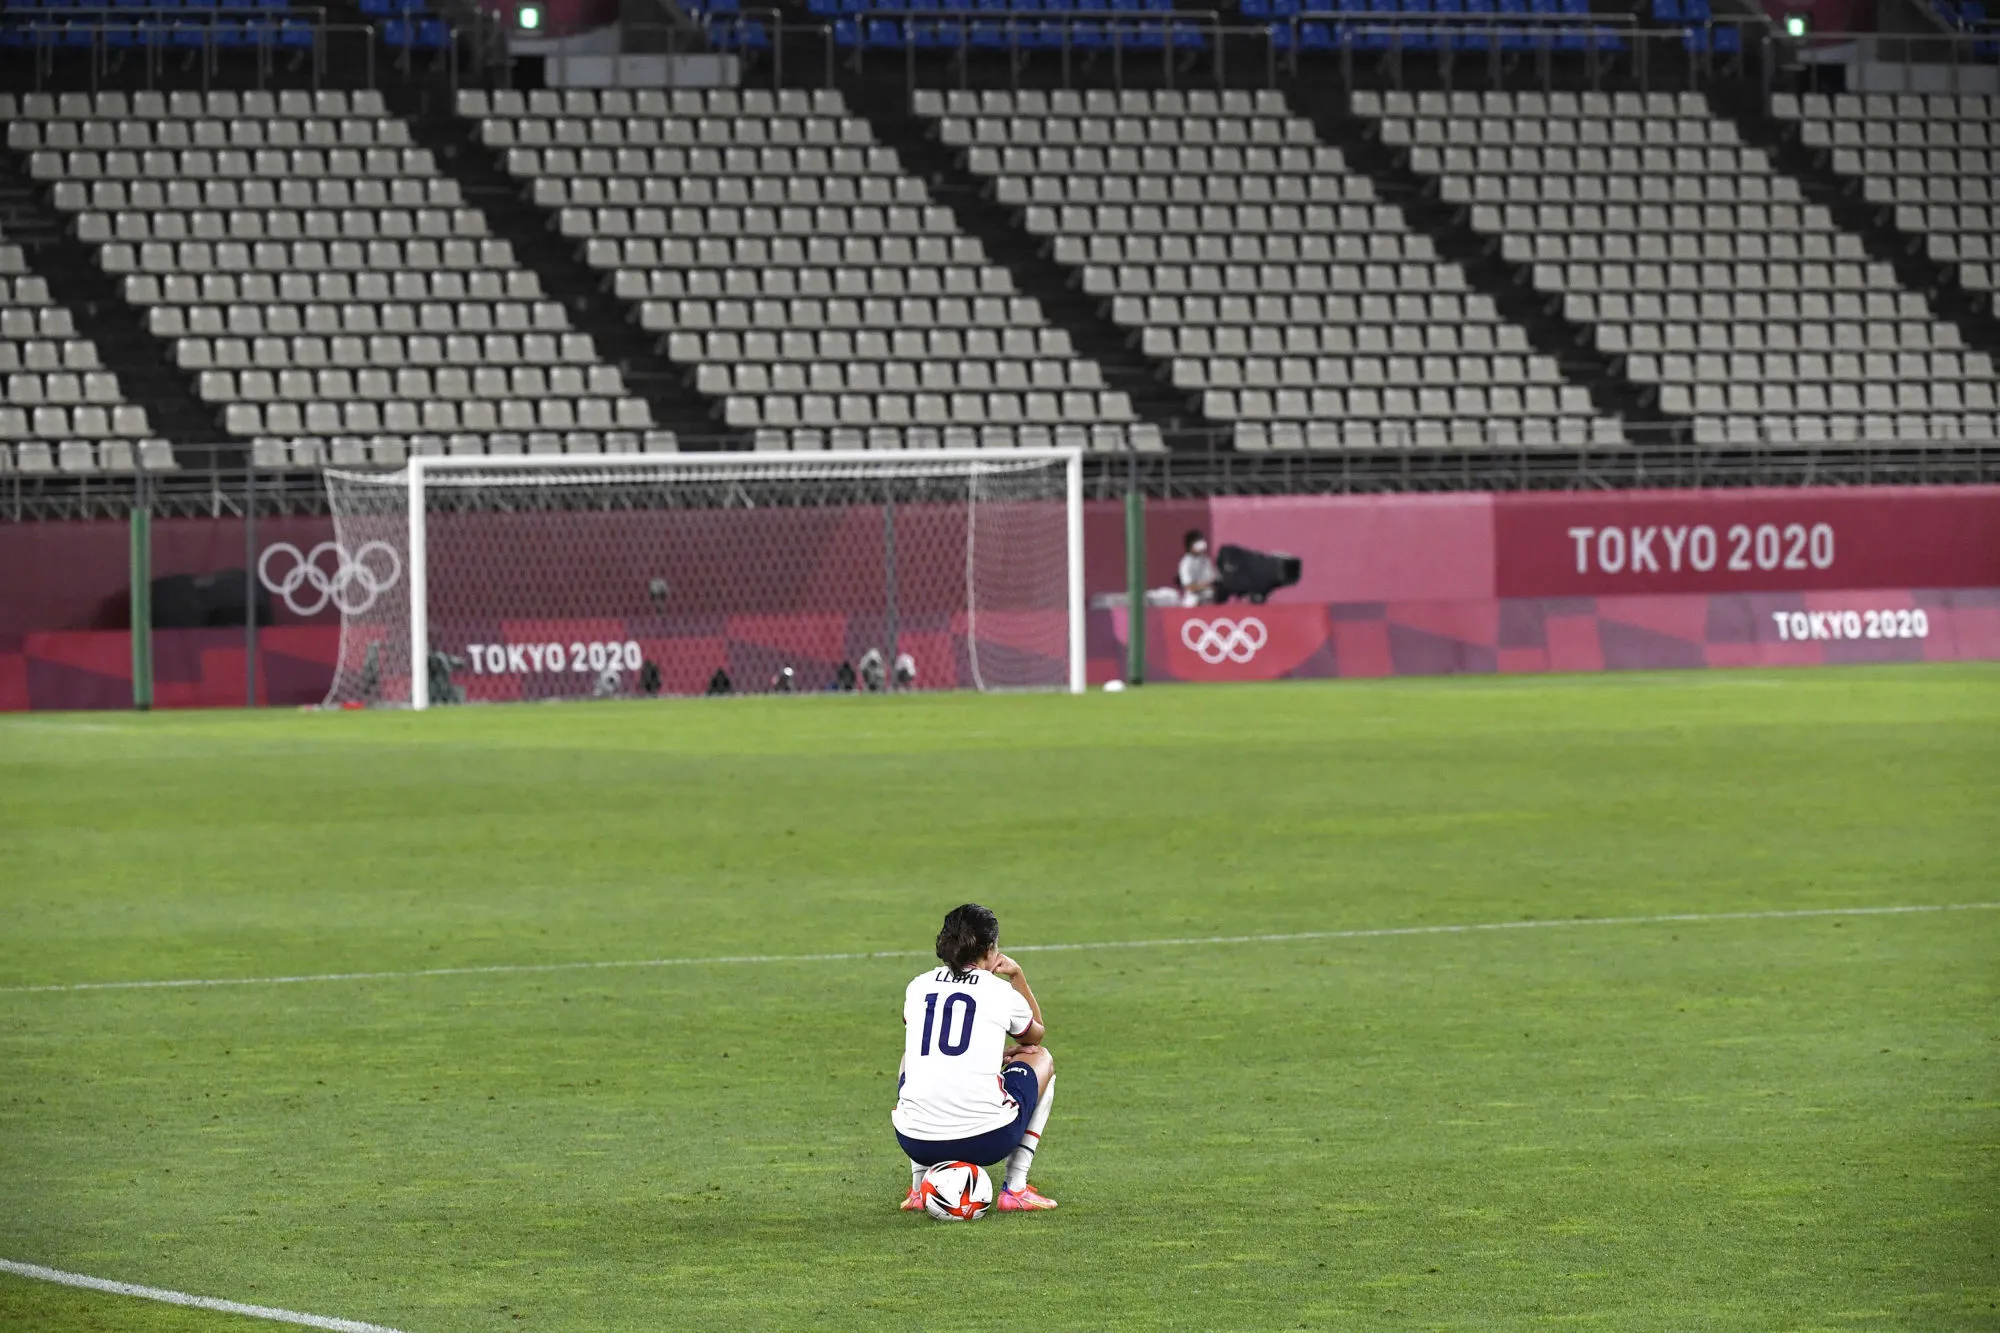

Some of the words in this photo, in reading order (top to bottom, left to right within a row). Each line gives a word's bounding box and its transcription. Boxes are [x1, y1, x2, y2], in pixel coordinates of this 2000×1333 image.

[1568, 524, 1717, 574] TOKYO
[1727, 522, 1835, 571] 2020
[1772, 609, 1862, 640] TOKYO
[1864, 609, 1929, 638] 2020
[467, 642, 566, 674] TOKYO
[569, 640, 642, 672] 2020
[920, 992, 977, 1056] 10
